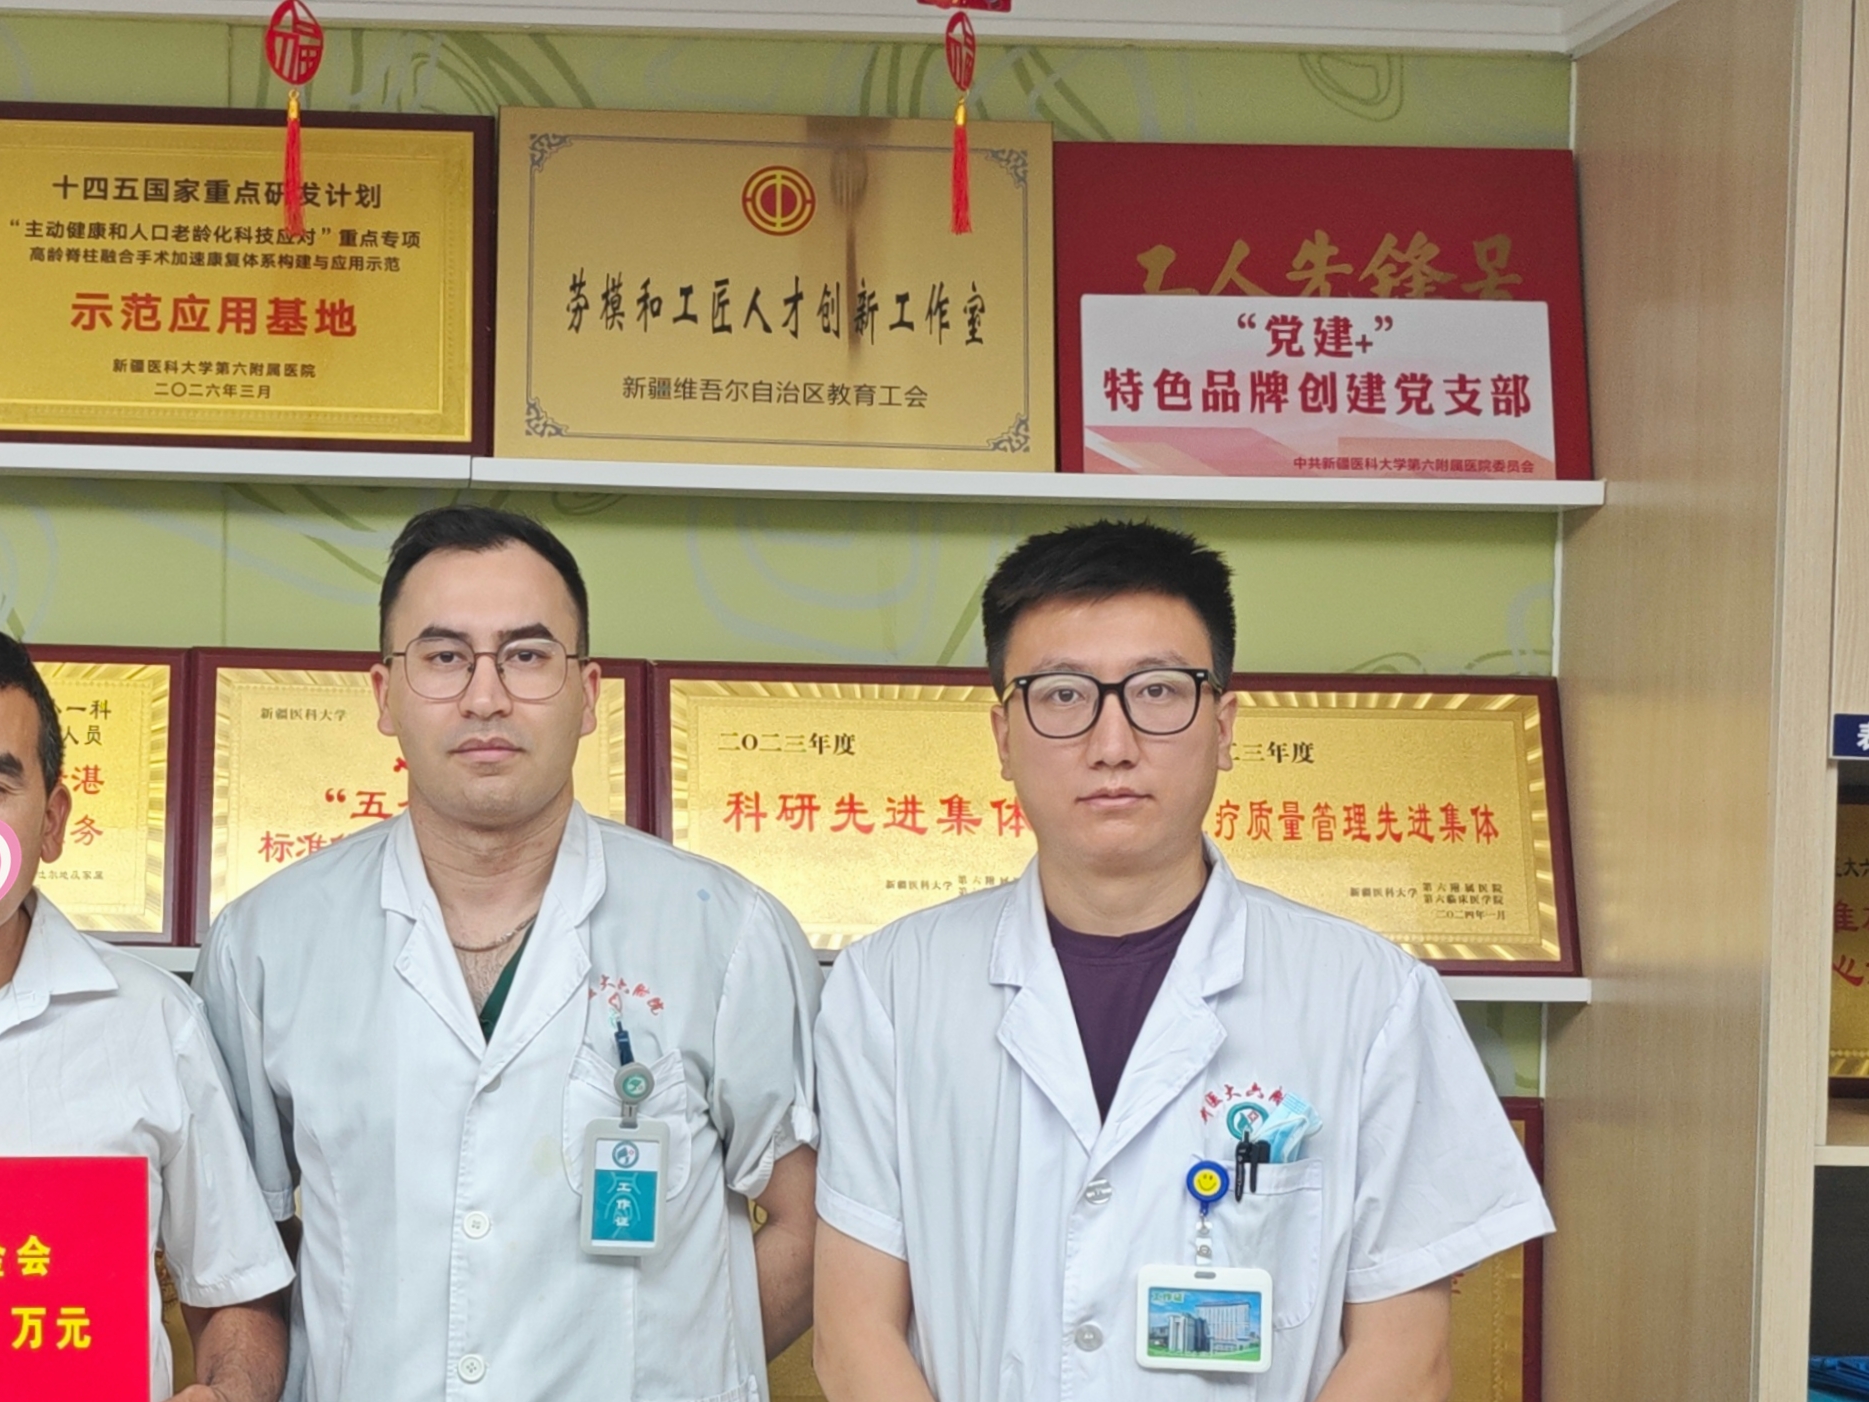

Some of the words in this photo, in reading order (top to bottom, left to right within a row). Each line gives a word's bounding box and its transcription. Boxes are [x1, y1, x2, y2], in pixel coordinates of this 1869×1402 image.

[52, 174, 382, 209] 十四五国家重点研发计划
[70, 292, 358, 337] 示范应用基地
[564, 267, 988, 346] 劳模和工匠人才创新工作室
[1237, 312, 1394, 358] “党建+”
[112, 358, 317, 379] 新疆医科大学第六附属医院
[622, 375, 929, 408] 新疆维吾尔自治区教育工会
[1103, 367, 1532, 418] 特色品牌创建党支部
[1293, 455, 1535, 474] 中共新疆医科大学第六附属医院委员会
[53, 699, 112, 720] 一科
[261, 707, 347, 722] 新疆医科大学
[723, 791, 1032, 837] 科研先进集体
[1214, 799, 1500, 845] 疗质量管理先进集体
[258, 830, 345, 863] 标准
